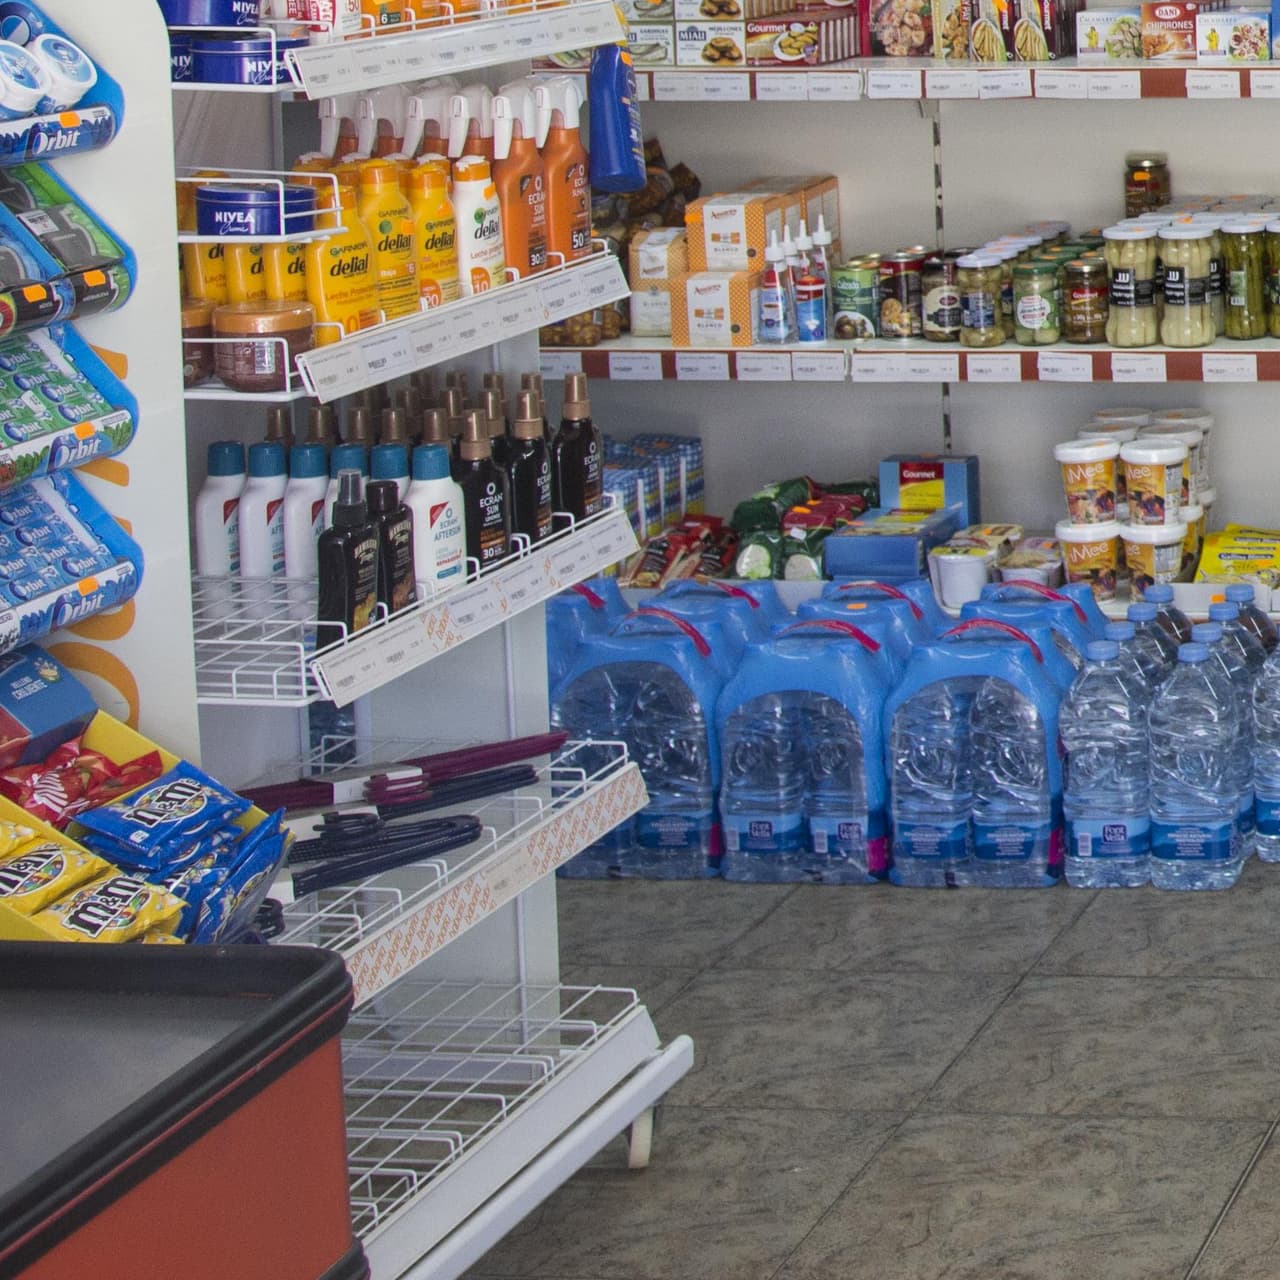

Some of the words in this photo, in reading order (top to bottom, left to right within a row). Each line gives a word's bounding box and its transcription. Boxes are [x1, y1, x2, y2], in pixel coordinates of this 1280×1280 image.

[1157, 8, 1179, 17] DANI
[747, 22, 787, 34] Gourmet
[1146, 20, 1194, 30] CHIPIRONES
[679, 31, 706, 41] MIAU
[31, 129, 80, 156] Orbit
[215, 211, 255, 224] NIVEA
[378, 234, 411, 252] delial
[425, 231, 455, 250] delial
[572, 233, 584, 250] 50
[330, 254, 368, 277] delial
[54, 438, 102, 468] Orbit
[903, 470, 935, 480] Gourmet
[480, 493, 503, 508] ECRAN
[486, 506, 499, 517] SUN
[434, 525, 462, 543] AFTERSUN
[483, 549, 494, 560] 30
[54, 593, 106, 628] Orbit
